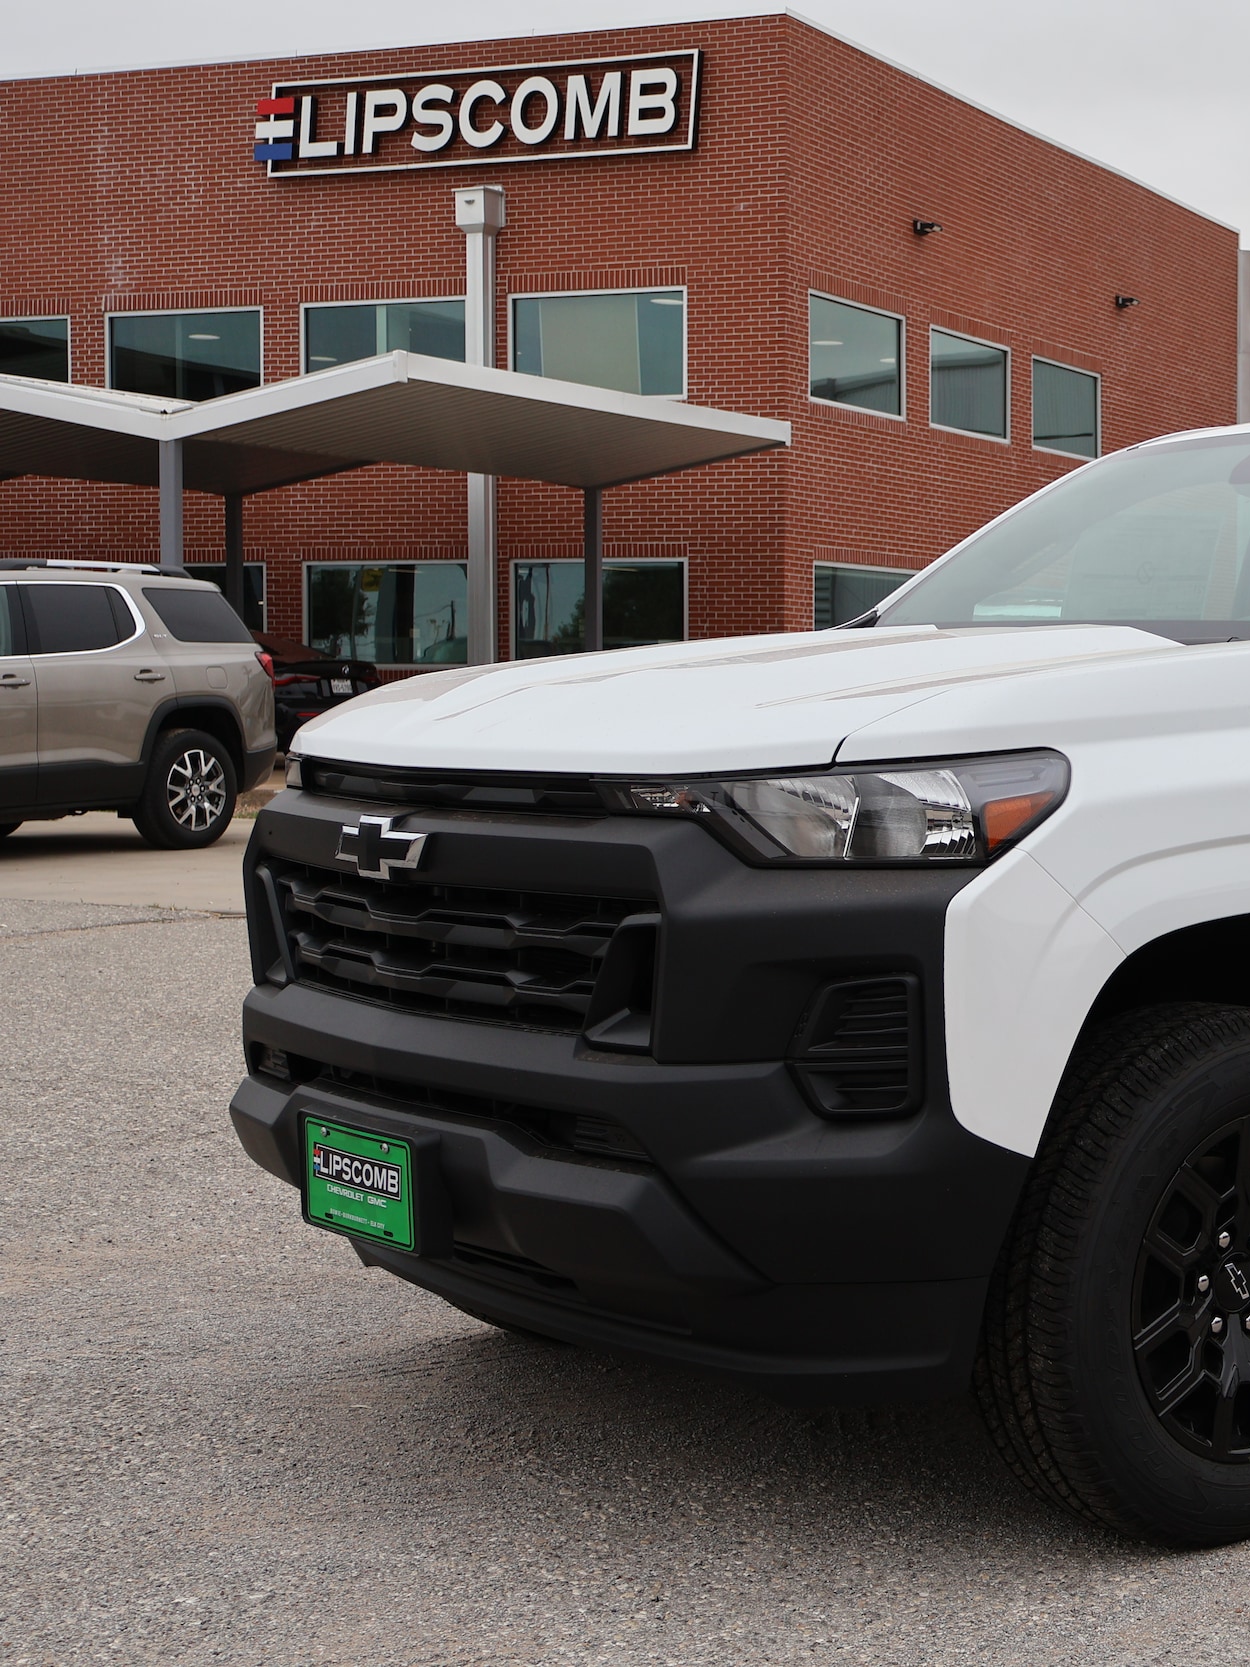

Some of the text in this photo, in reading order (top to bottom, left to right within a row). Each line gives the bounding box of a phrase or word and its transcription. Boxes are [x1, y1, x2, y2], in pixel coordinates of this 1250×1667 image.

[298, 68, 678, 158] LIPSCOMB
[320, 1151, 399, 1193] LIPSCOMB
[327, 1184, 387, 1208] CHEVROLET GMC
